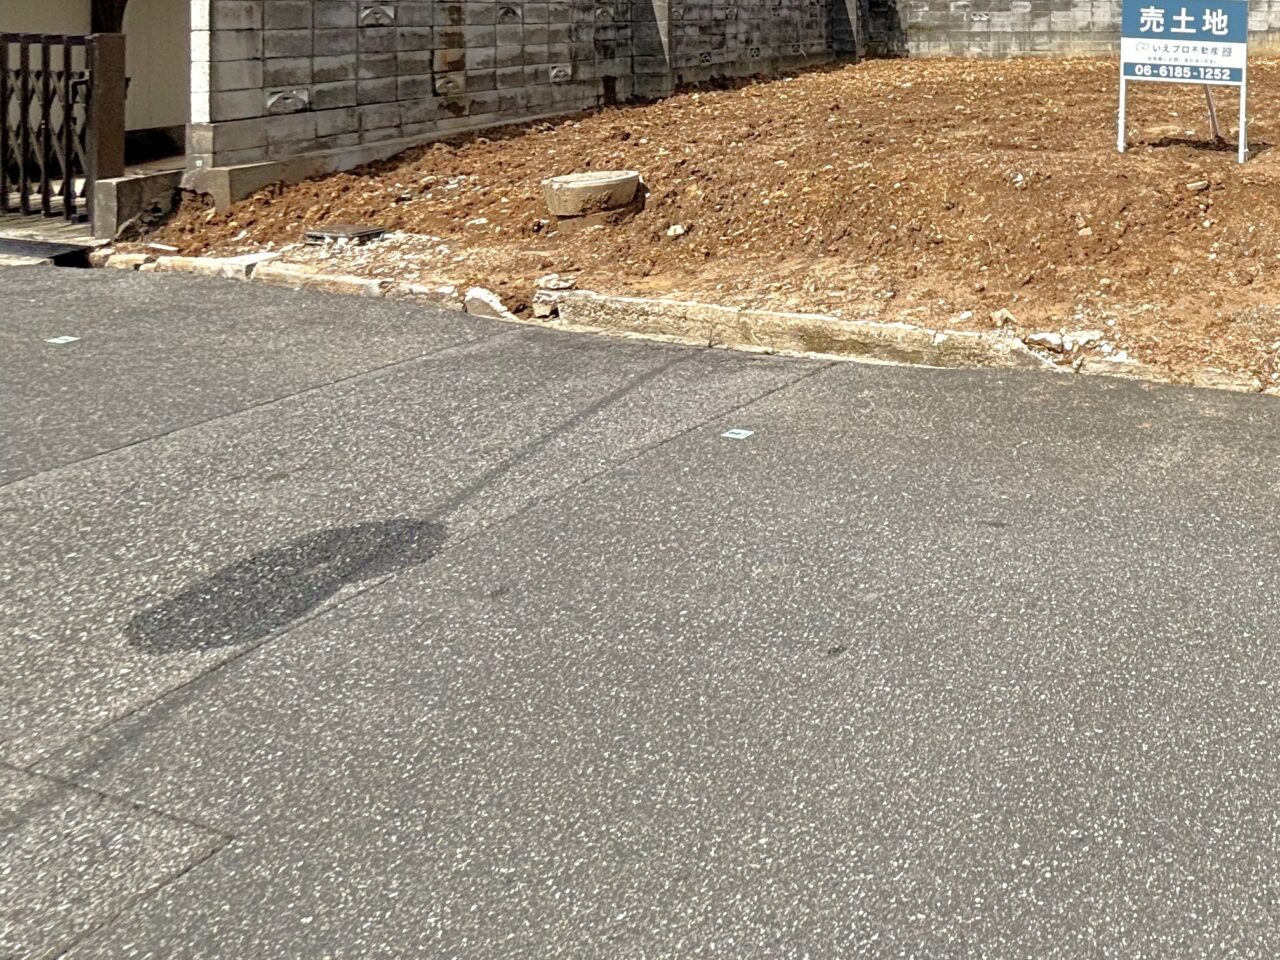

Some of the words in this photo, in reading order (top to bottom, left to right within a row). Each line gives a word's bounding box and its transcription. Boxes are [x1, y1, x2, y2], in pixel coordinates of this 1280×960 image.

[1140, 6, 1229, 35] 売土地
[1135, 64, 1230, 80] 06-6185-1252
